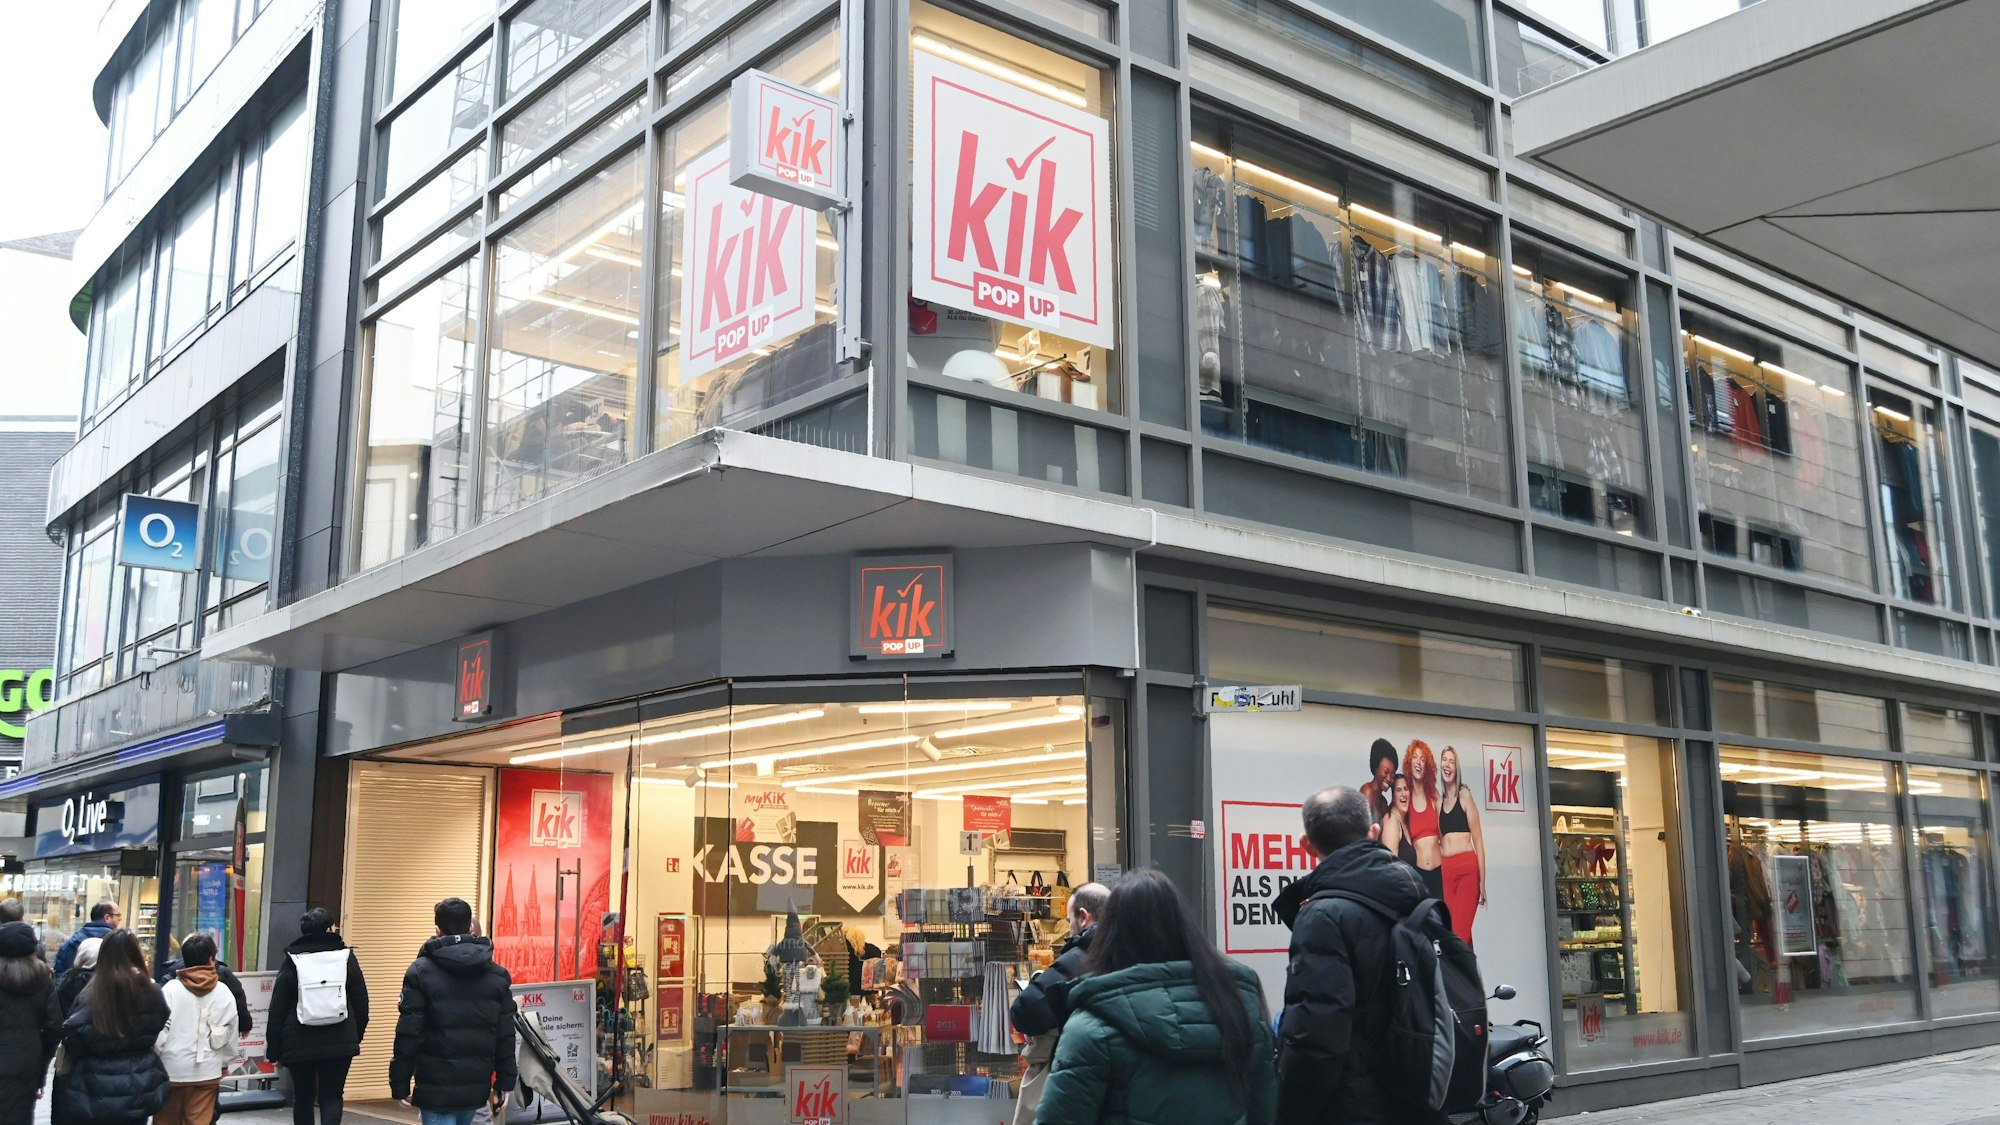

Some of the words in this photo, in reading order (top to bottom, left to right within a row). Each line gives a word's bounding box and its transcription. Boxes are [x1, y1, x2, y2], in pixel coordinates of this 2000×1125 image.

[766, 106, 827, 175] kik
[778, 166, 797, 179] POP
[800, 173, 812, 183] UP
[947, 130, 1084, 295] kik
[700, 194, 796, 332] kik
[978, 281, 1020, 309] POP
[1029, 294, 1055, 317] UP
[717, 325, 746, 353] POP
[751, 313, 770, 337] UP
[869, 573, 936, 638] kik
[883, 642, 903, 651] POP
[908, 642, 920, 650] UP
[460, 650, 485, 703] kik
[1489, 751, 1520, 804] kik
[78, 791, 107, 837] Live
[537, 796, 576, 839] kik
[692, 843, 818, 885] KASSE
[845, 845, 872, 875] kik
[1231, 833, 1319, 870] MEH
[842, 883, 874, 891] www.kik.de
[1232, 876, 1272, 897] ALS
[1233, 903, 1282, 925] DEN
[573, 990, 584, 1001] kik
[542, 1015, 563, 1023] Deine
[556, 1022, 584, 1031] sichern:
[1583, 1000, 1601, 1034] kik
[1632, 1028, 1681, 1048] www.kik.de
[795, 1074, 839, 1117] kik
